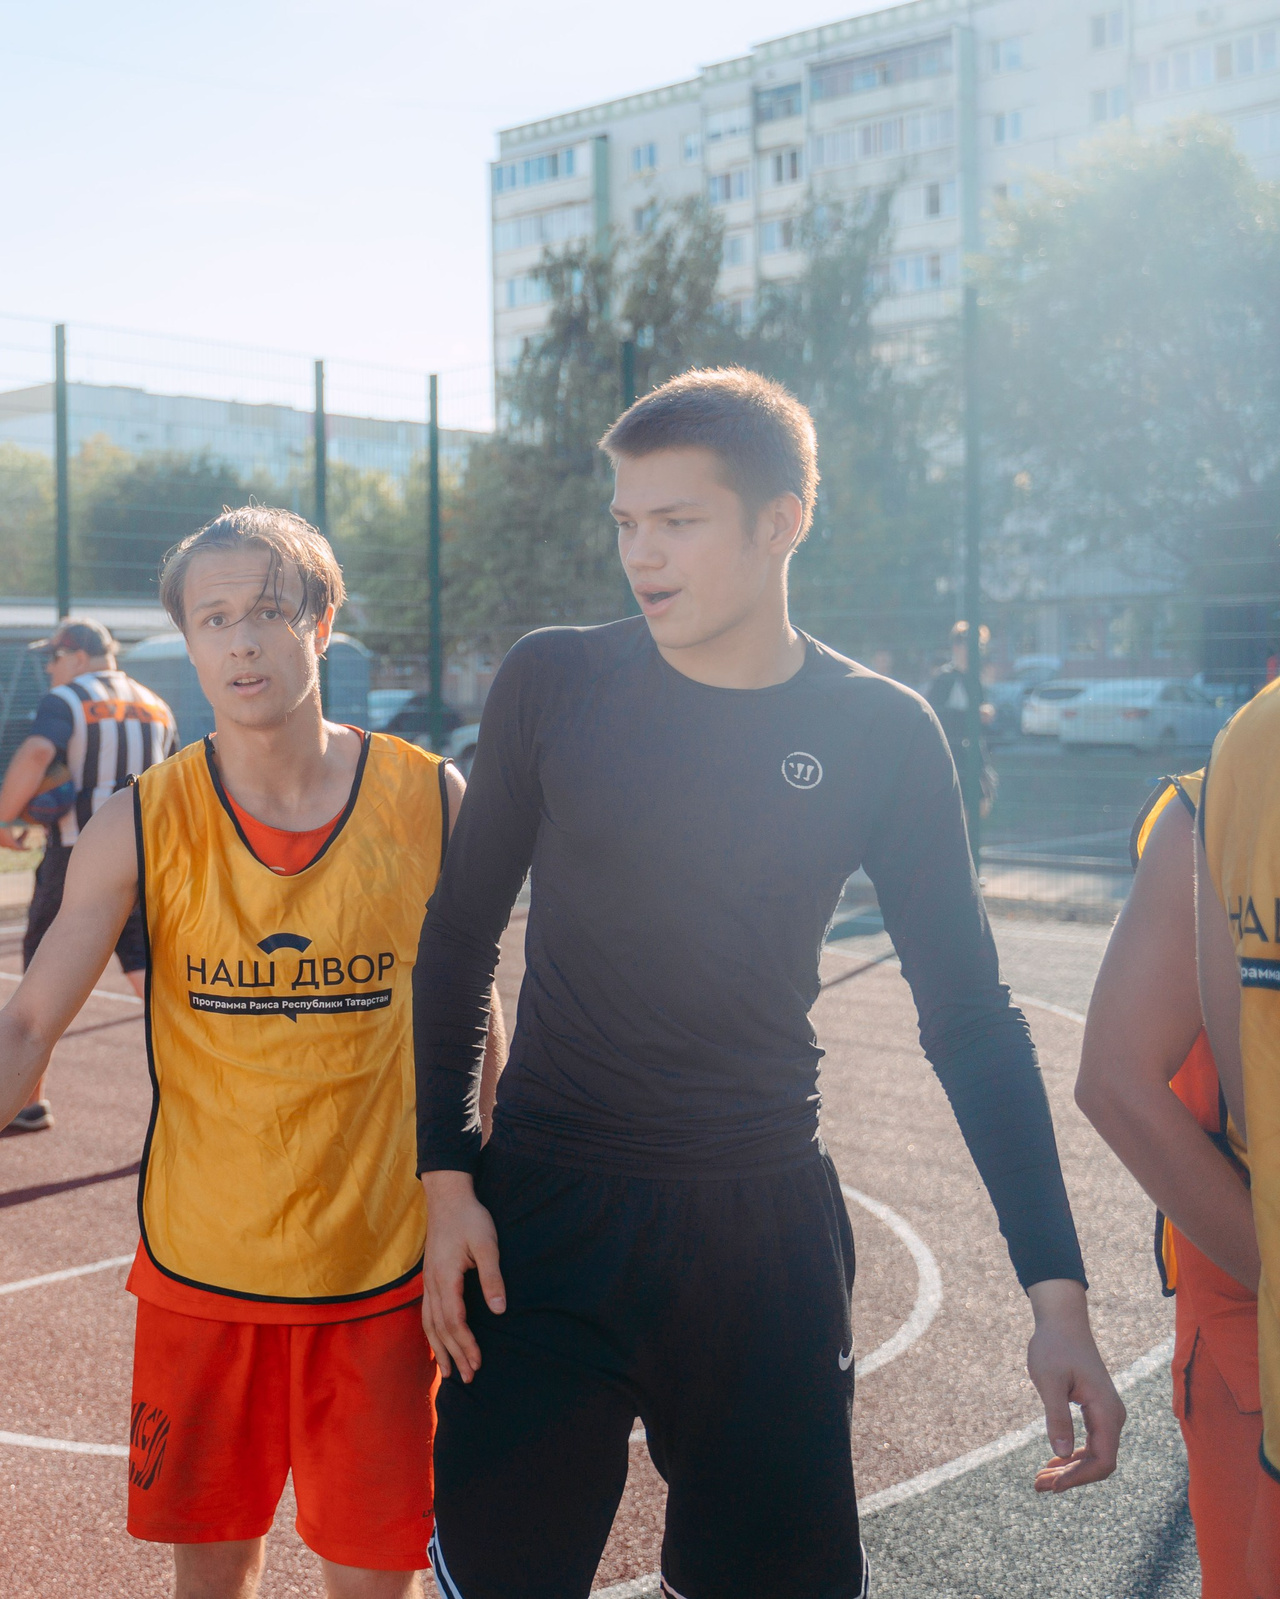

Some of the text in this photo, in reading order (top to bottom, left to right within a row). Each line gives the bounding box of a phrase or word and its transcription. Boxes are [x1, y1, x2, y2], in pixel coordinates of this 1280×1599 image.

[1227, 895, 1280, 943] НА
[187, 952, 395, 990] НАШ ДВОР
[192, 994, 389, 1010] Программа Раиса Республики Татарстан
